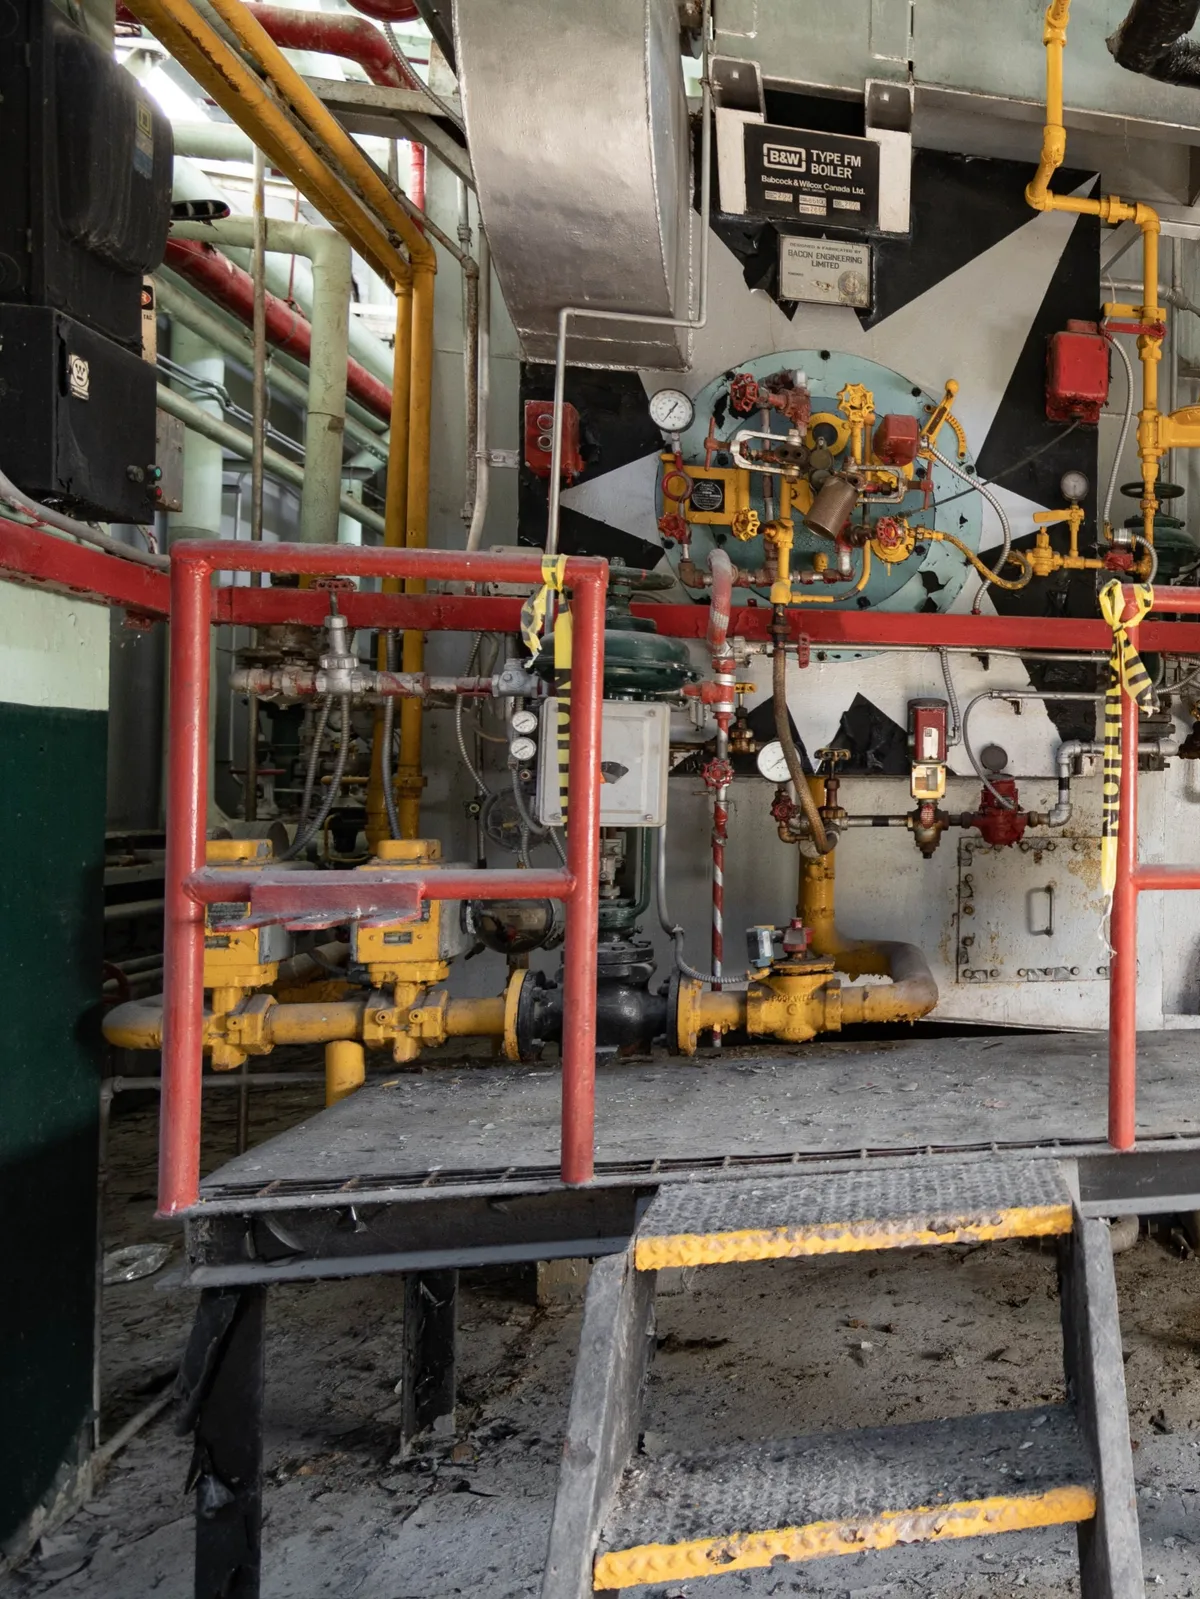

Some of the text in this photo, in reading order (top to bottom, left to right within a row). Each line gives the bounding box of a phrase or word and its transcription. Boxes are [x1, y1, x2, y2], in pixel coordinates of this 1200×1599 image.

[769, 149, 800, 166] B&W
[810, 149, 862, 168] TYPE FM
[810, 163, 853, 179] BOILER
[761, 174, 793, 186] Babcock
[793, 178, 799, 186] &
[799, 180, 822, 190] Wilcox
[823, 183, 851, 193] Canada
[852, 186, 866, 195] Ltd.
[788, 249, 863, 265] BACON ENGINEERING
[811, 260, 840, 270] LIMITED
[1102, 643, 1123, 837] AUTION
